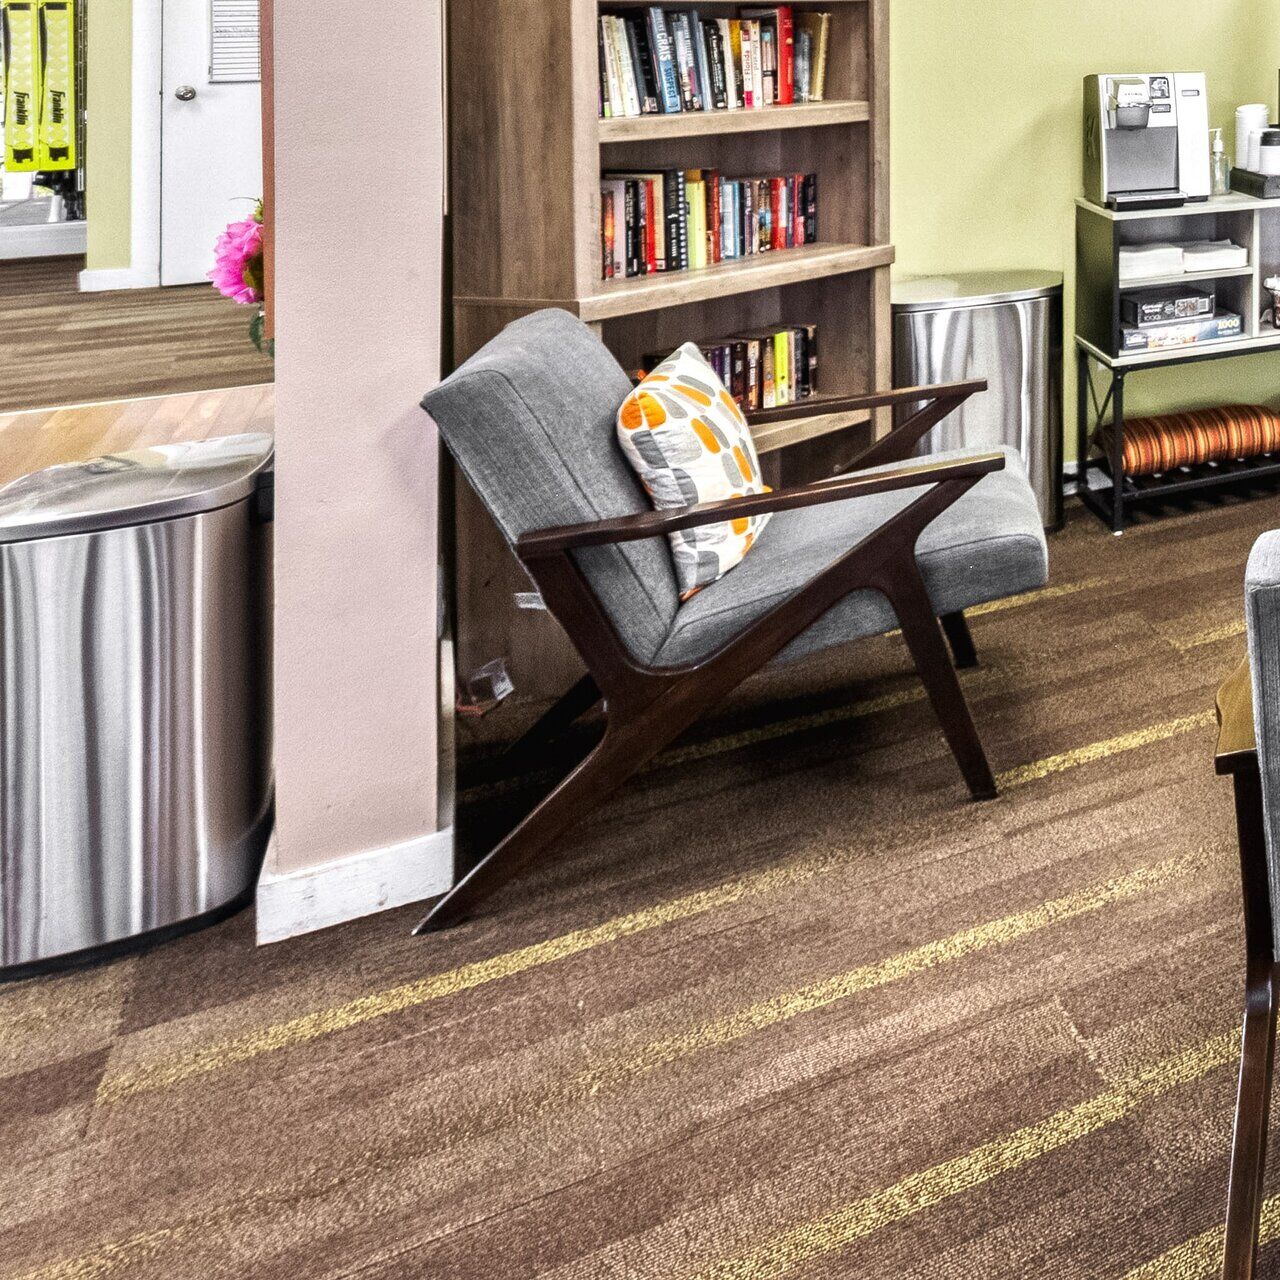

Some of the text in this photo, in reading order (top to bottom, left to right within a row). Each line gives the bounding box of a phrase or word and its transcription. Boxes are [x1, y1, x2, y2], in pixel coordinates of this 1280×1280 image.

[656, 32, 671, 62] CRAIS
[744, 50, 752, 75] Florida
[663, 67, 675, 99] SUSPECT
[14, 91, 30, 125] franklin
[50, 89, 66, 123] franklin
[1217, 319, 1239, 330] 1000
